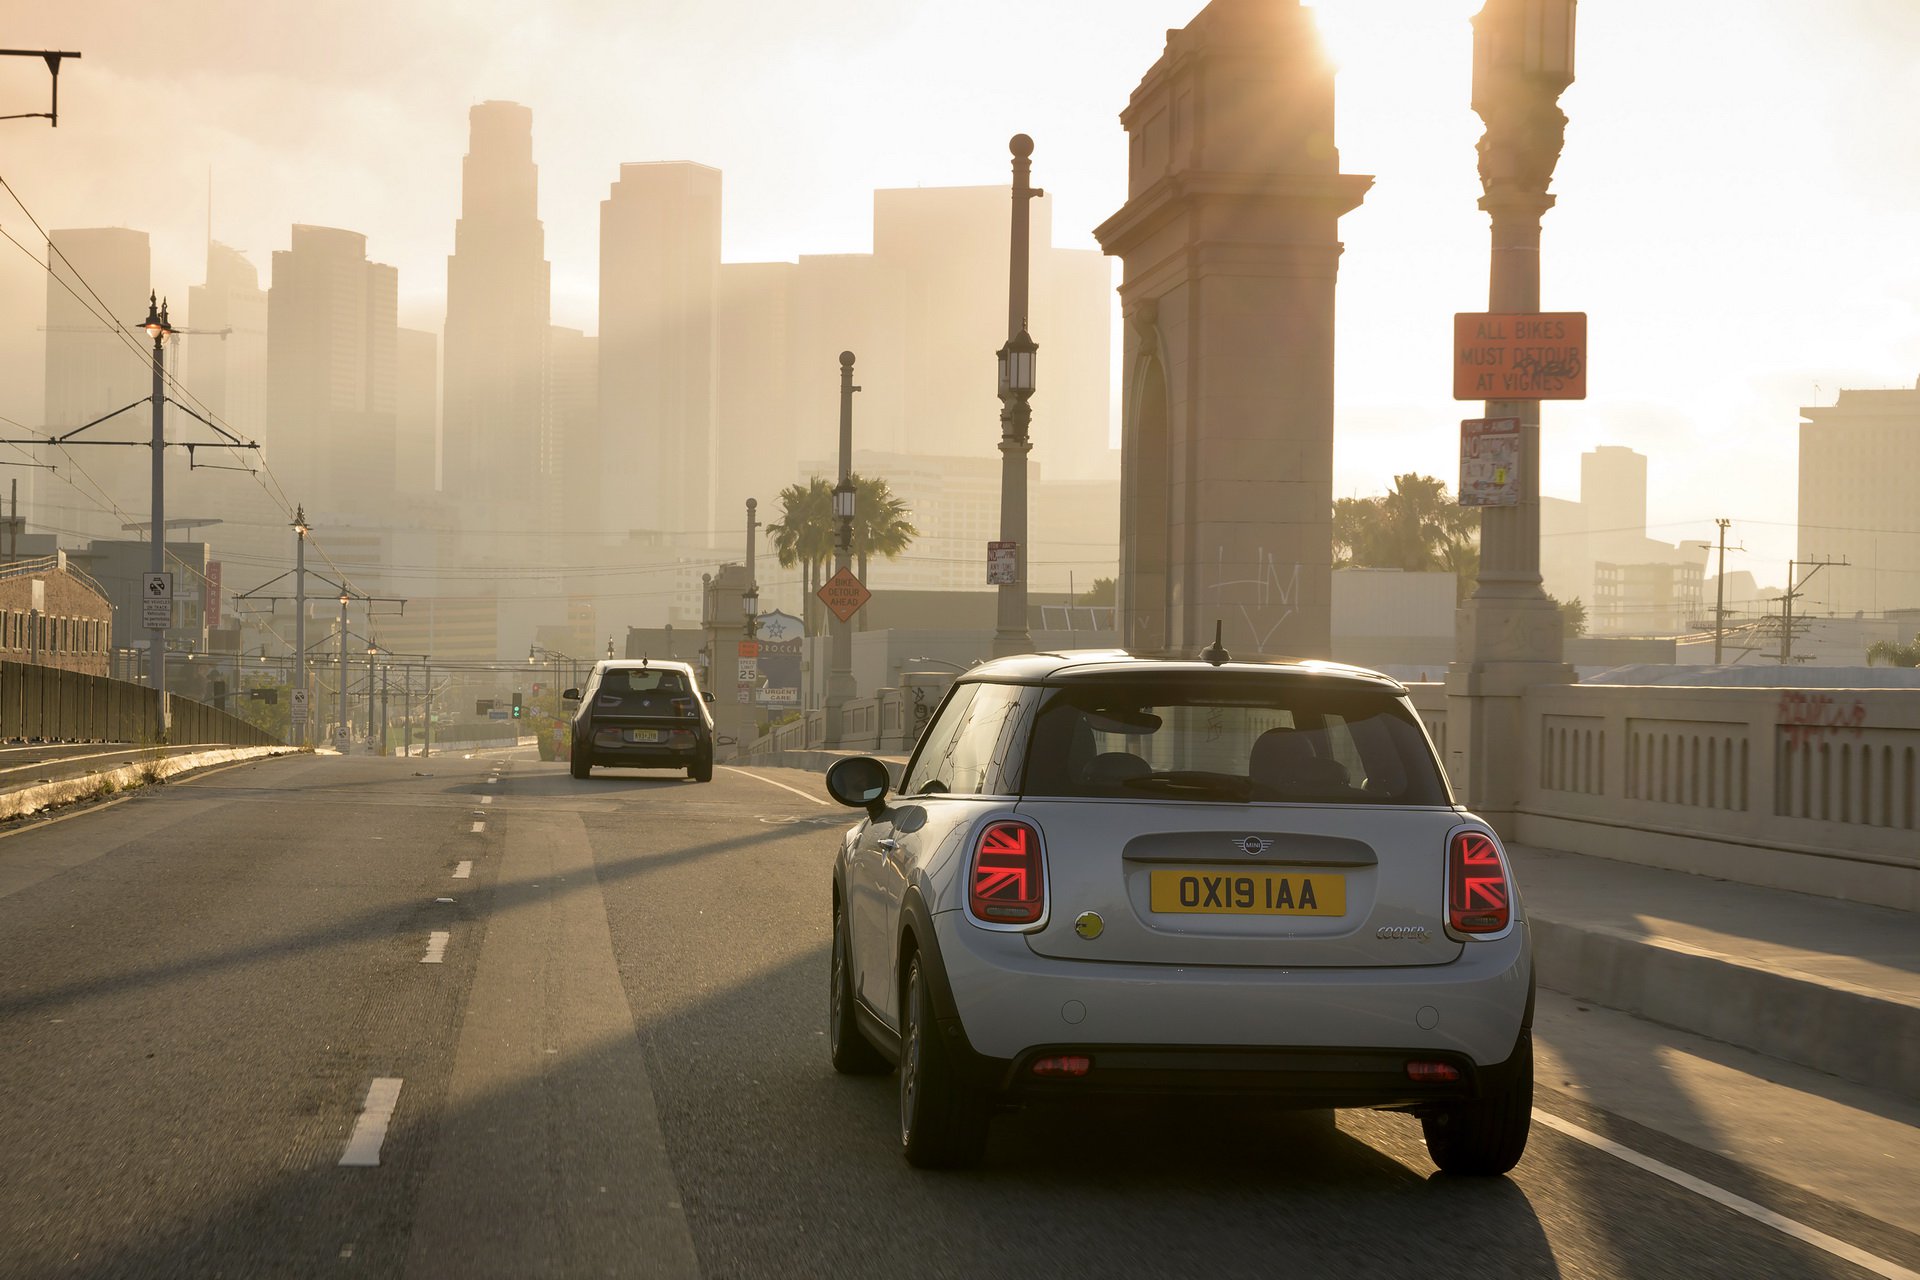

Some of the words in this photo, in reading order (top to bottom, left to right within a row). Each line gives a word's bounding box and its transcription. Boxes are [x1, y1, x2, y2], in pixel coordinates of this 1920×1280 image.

[1476, 321, 1506, 340] ALL
[1515, 321, 1565, 340] BIKES
[1461, 347, 1505, 366] MUST
[1513, 347, 1580, 366] DETOUR
[1476, 373, 1495, 392] AT
[1503, 373, 1565, 392] VIGNES
[988, 549, 997, 561] NO
[835, 578, 854, 587] BIKE
[828, 588, 860, 597] DETOUR
[831, 598, 858, 606] AHEAD
[739, 670, 756, 680] 25
[1179, 876, 1255, 909] OX19
[1265, 878, 1318, 910] IAA
[1376, 926, 1425, 940] COOPER
